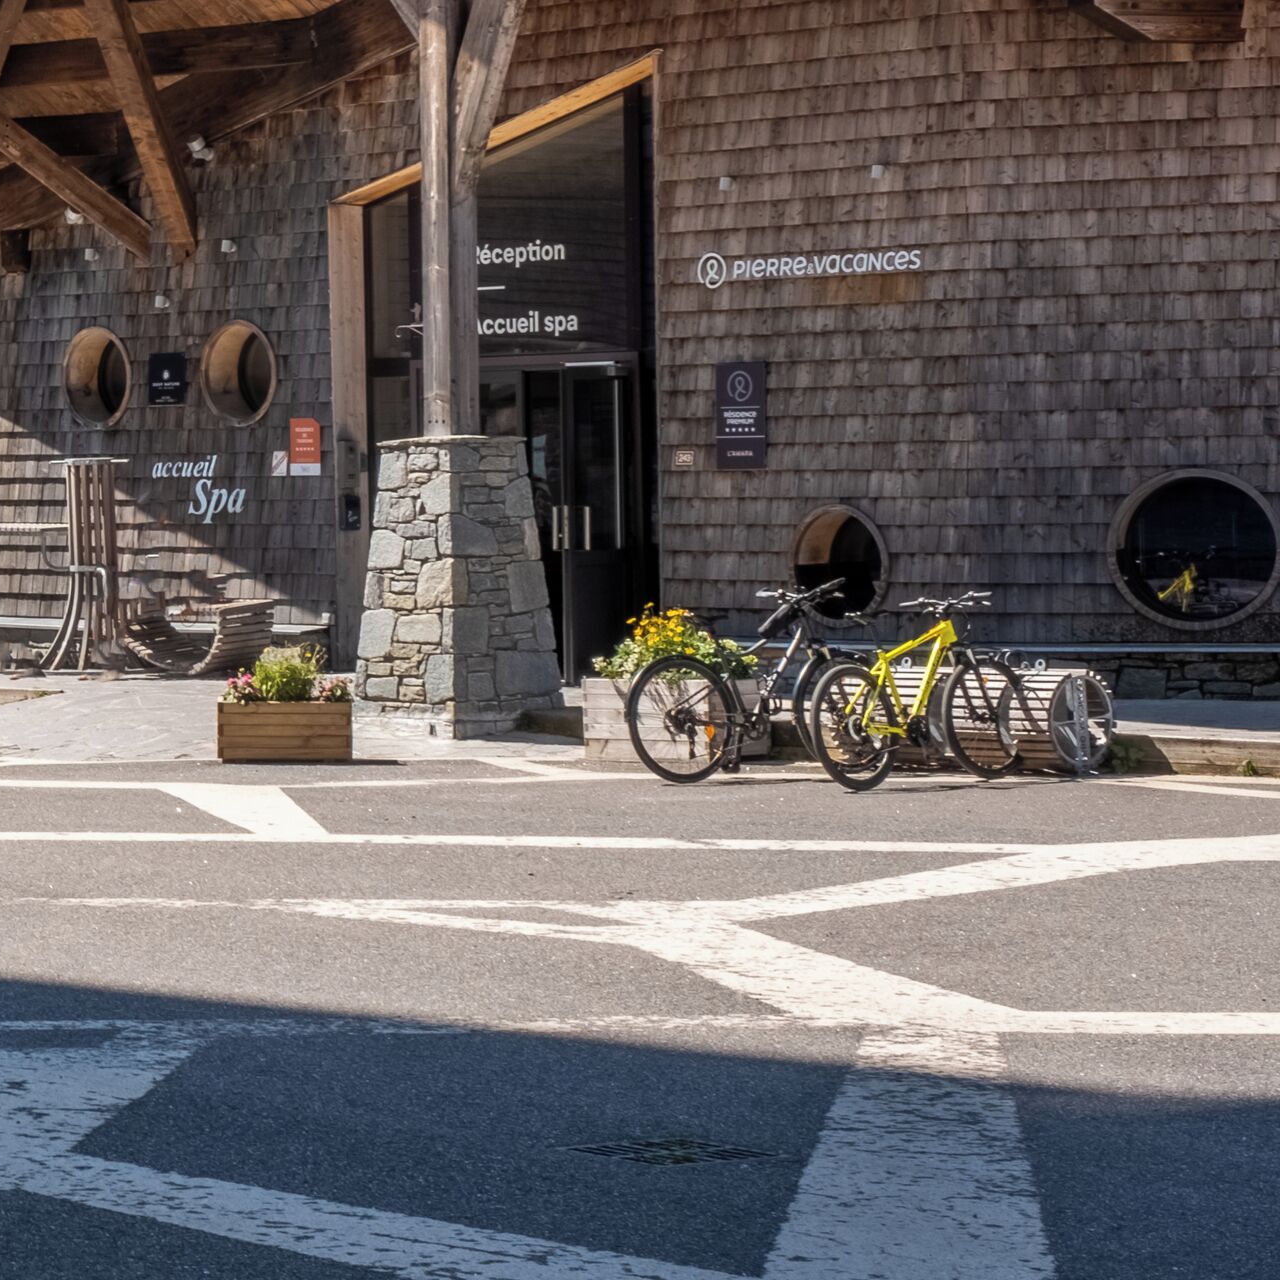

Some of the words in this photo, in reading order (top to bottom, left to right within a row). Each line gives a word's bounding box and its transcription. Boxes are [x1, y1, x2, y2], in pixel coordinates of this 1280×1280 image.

[544, 315, 578, 337] spa
[151, 455, 218, 478] accueil
[188, 479, 246, 524] Spa
